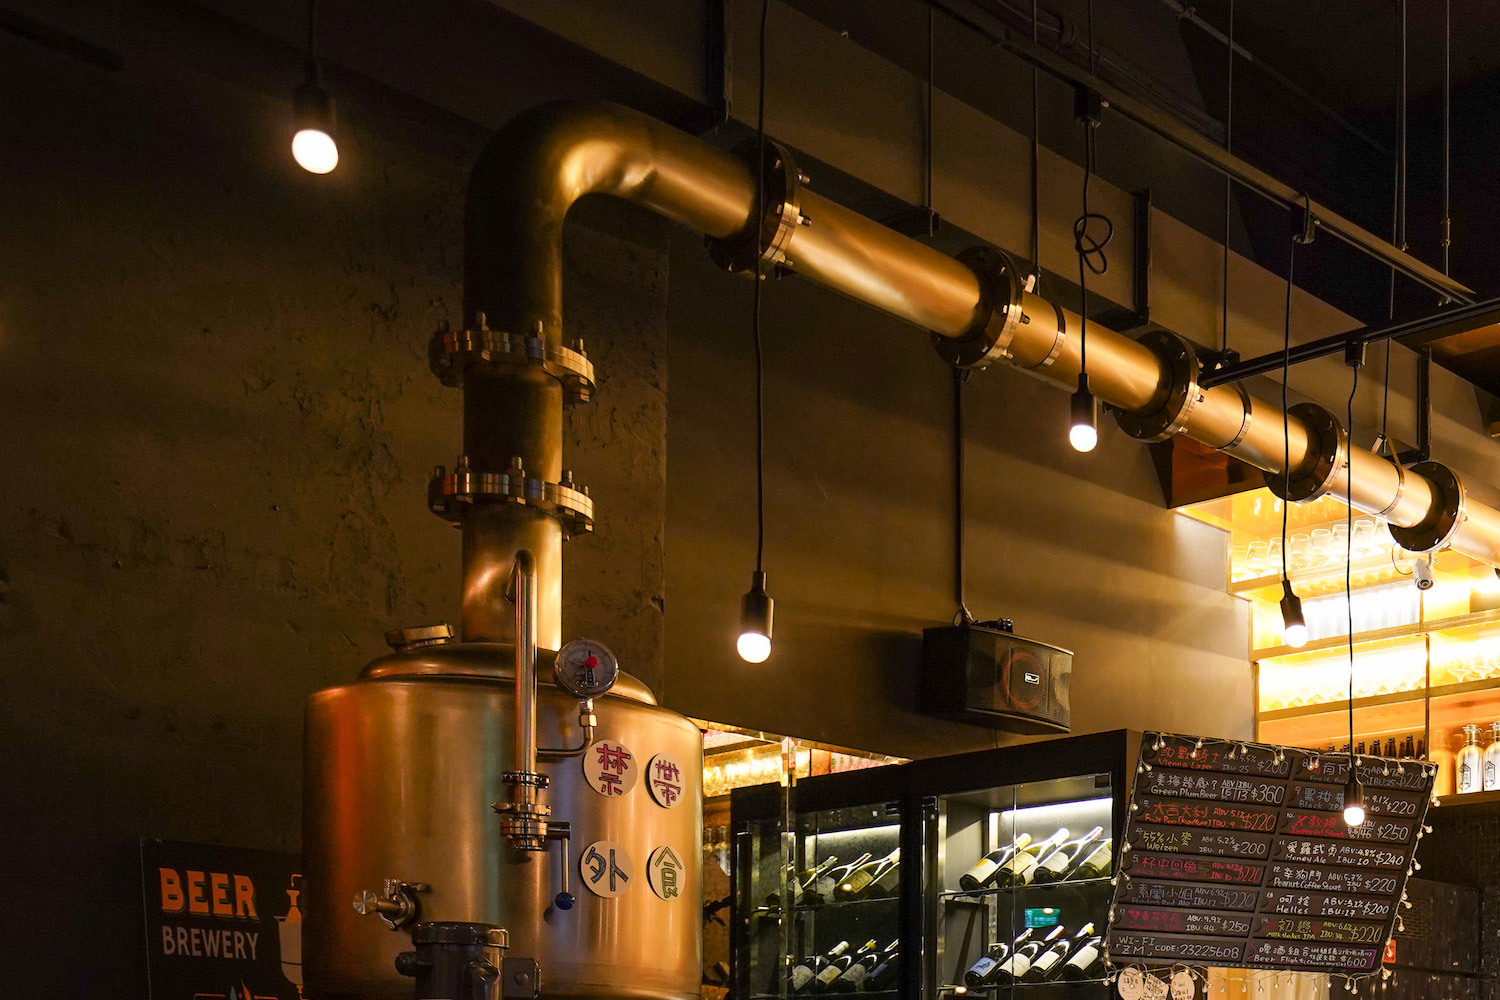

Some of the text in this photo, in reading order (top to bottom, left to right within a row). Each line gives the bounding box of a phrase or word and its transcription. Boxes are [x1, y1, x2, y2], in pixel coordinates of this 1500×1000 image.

[1257, 760, 1288, 775] $200
[1151, 786, 1178, 796] Green
[1180, 788, 1200, 798] Plum
[1251, 784, 1285, 804] $360
[1153, 802, 1209, 817] 大吉大利
[1299, 800, 1323, 809] Black
[1387, 801, 1416, 815] $220
[1240, 812, 1277, 831] $220
[1377, 823, 1409, 840] $250
[1146, 842, 1179, 852] Weizen
[1232, 841, 1266, 855] $200
[1285, 853, 1312, 863] Honey
[1374, 851, 1404, 866] $240
[1273, 877, 1300, 887] Peanut
[1364, 878, 1396, 892] $220
[159, 867, 260, 920] BEER
[1220, 890, 1256, 908] $220
[1276, 904, 1309, 915] Helles
[1362, 902, 1389, 916] $200
[1221, 920, 1249, 933] $250
[1349, 925, 1383, 942] $220
[162, 926, 259, 960] BREWERY
[1119, 936, 1155, 946] WI-FI
[1180, 944, 1240, 959] 23225608
[1254, 954, 1275, 963] Beer
[1346, 956, 1367, 968] 600
